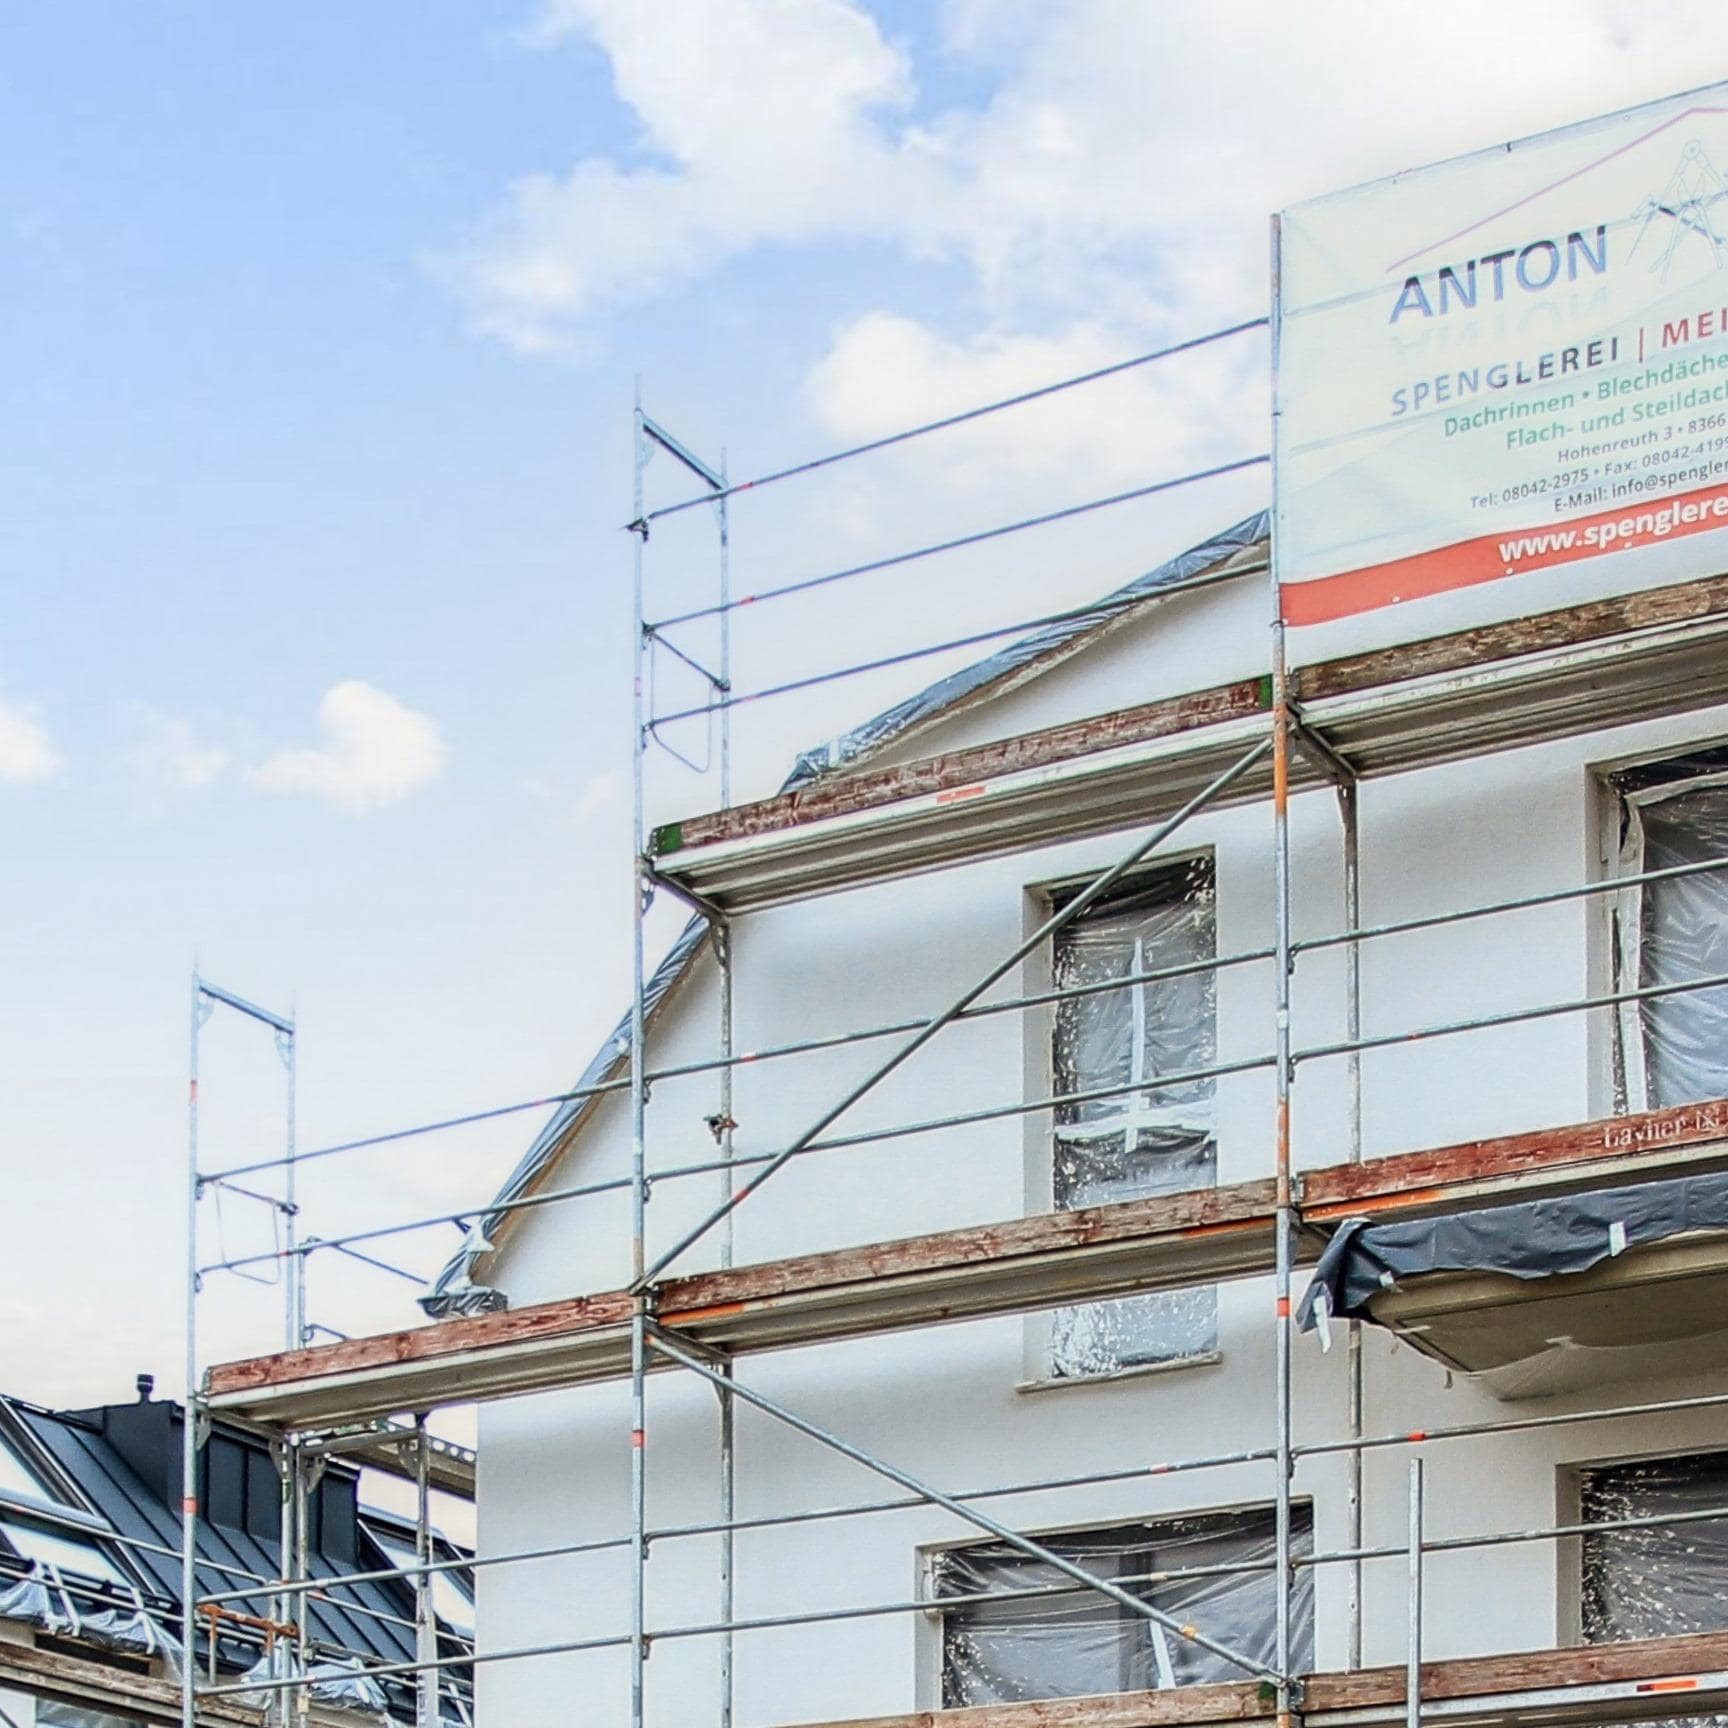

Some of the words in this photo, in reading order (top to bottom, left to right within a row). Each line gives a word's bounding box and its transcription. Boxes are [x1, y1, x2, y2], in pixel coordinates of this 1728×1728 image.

[1389, 224, 1608, 325] ANTON
[1390, 336, 1619, 417] SPENGLEREI
[1444, 391, 1576, 438] Dachrinnen
[1506, 421, 1574, 451] Flach-
[1581, 406, 1626, 435] und
[1557, 427, 1659, 464] Hohenreuth
[1663, 425, 1674, 442] 3
[1470, 492, 1499, 510] Tel:
[1501, 466, 1590, 504] 08042-2975
[1604, 459, 1639, 477] Fax:
[1553, 485, 1609, 513] E-Mail:
